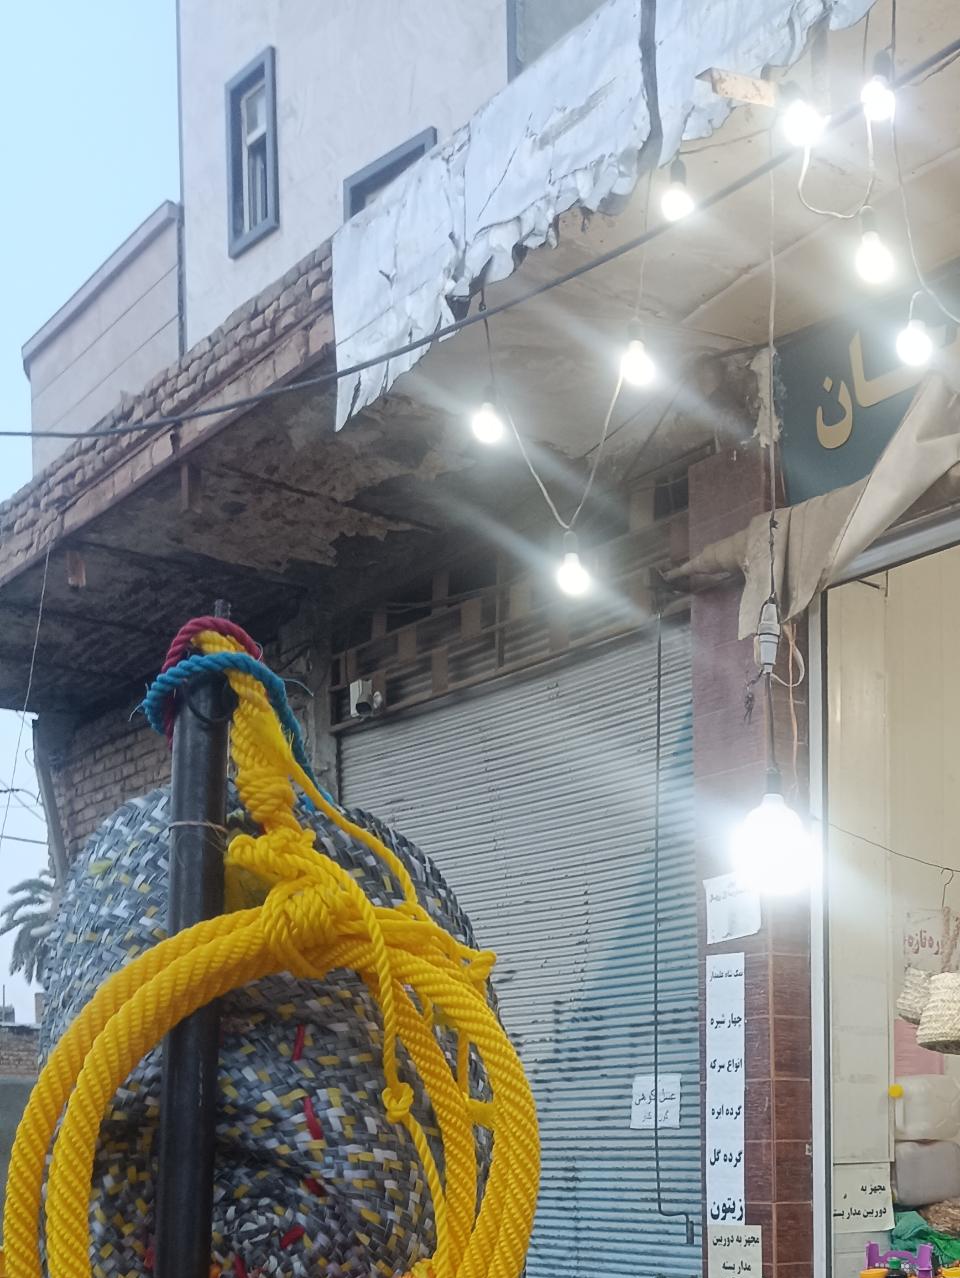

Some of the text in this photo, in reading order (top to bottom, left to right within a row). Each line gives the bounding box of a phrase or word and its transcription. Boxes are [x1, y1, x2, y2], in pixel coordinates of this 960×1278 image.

[710, 1012, 742, 1029] چهار شیره
[710, 1058, 743, 1073] انواع سرکه
[860, 1184, 886, 1195] مجهز به
[710, 1197, 744, 1221] زیتون
[846, 1207, 861, 1220] مدار
[863, 1207, 887, 1218] دوربین
[712, 1234, 760, 1248] مجهز به دوربین
[722, 1259, 752, 1275] مدار بسته
